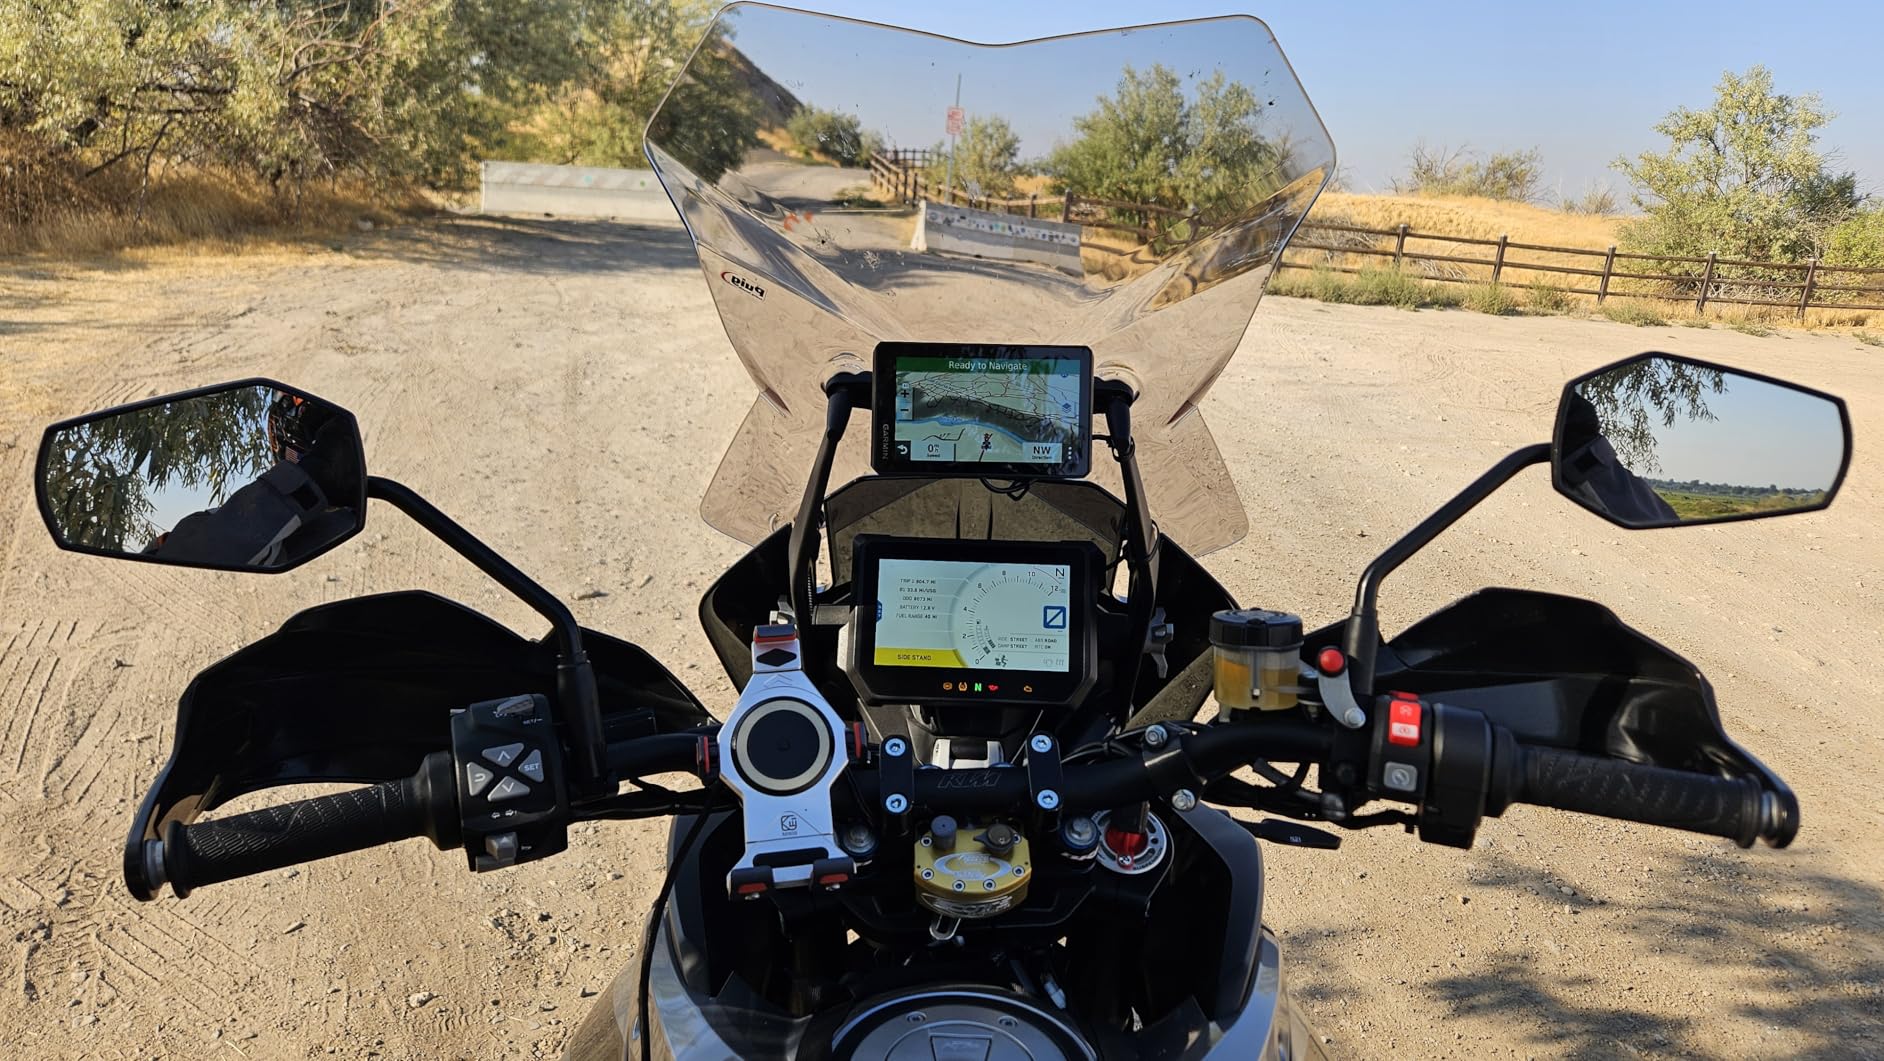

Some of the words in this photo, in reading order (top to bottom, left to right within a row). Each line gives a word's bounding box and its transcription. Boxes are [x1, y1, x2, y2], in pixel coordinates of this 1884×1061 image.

[949, 360, 976, 371] Ready
[978, 362, 987, 370] to
[989, 361, 1028, 372] Navigate
[1033, 446, 1051, 455] NW
[974, 682, 982, 692] N
[523, 763, 540, 772] SET
